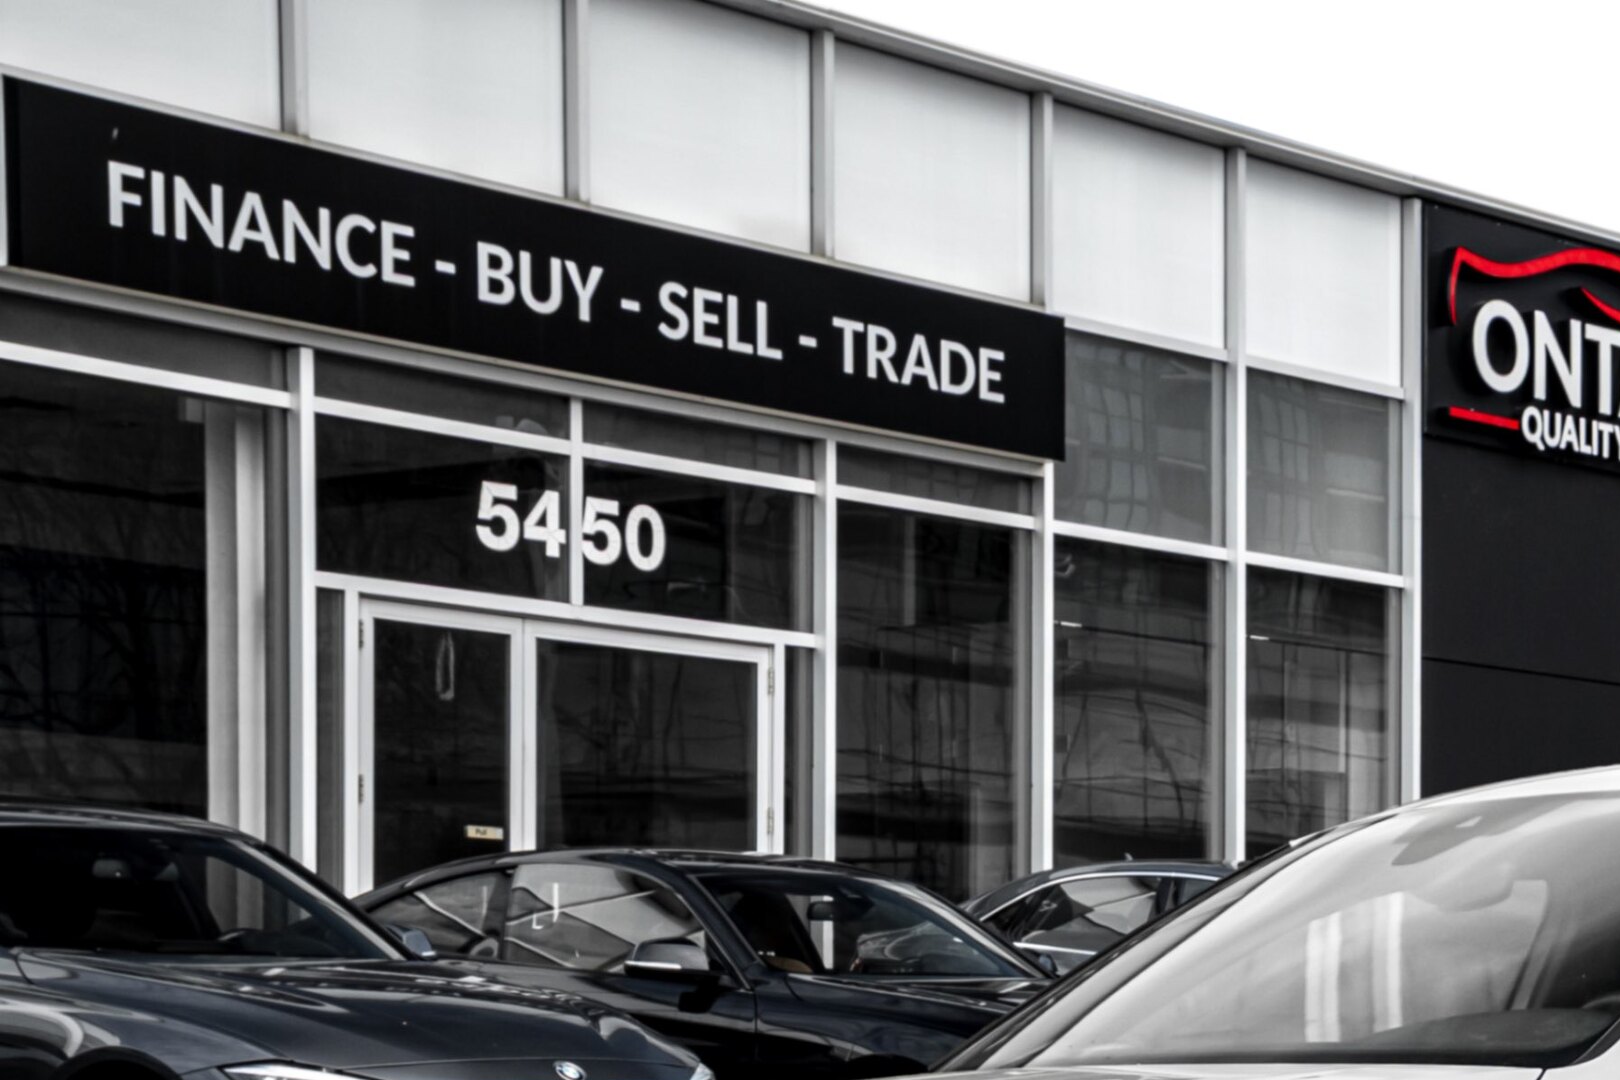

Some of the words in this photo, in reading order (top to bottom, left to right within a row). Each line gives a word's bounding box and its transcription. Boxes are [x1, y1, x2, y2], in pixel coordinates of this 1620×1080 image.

[107, 161, 416, 287] FINANCE
[478, 242, 602, 321] BUY
[659, 282, 782, 359] SELL
[833, 317, 1004, 402] TRADE
[475, 480, 666, 572] 5450
